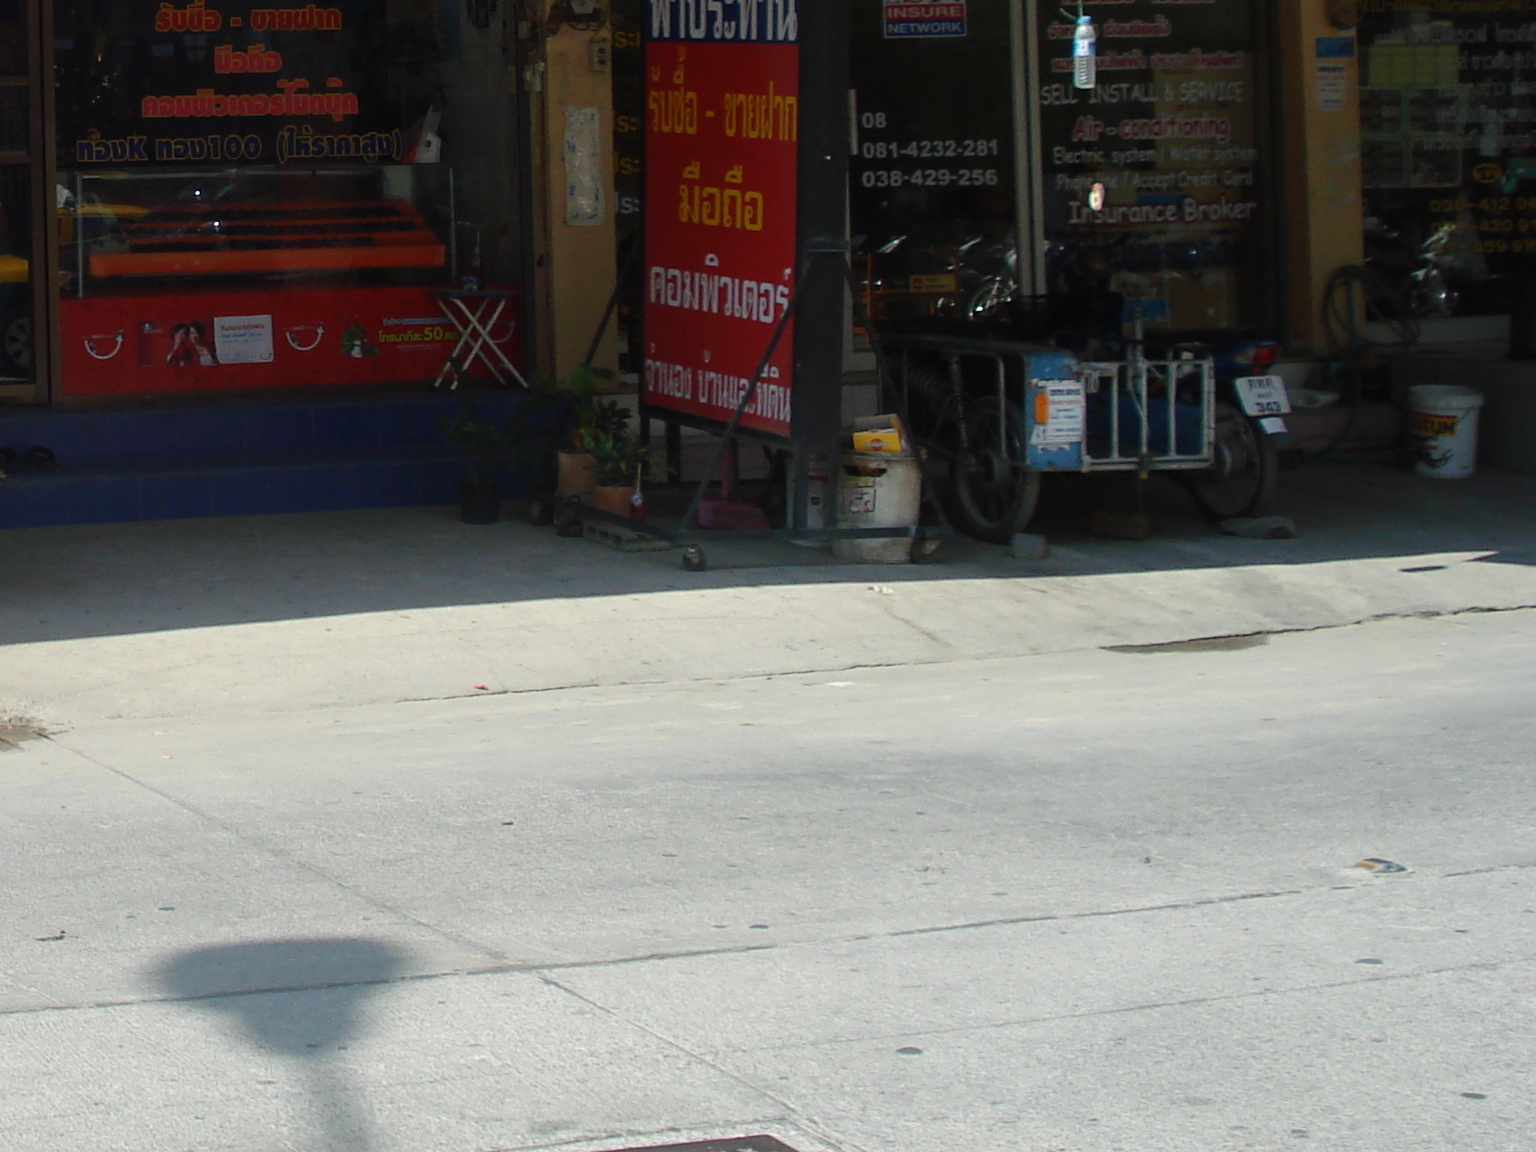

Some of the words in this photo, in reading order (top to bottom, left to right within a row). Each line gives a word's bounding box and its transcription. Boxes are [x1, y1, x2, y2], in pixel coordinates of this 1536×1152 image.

[250, 5, 342, 32] ขายฝาก
[886, 4, 962, 19] INSURE
[886, 20, 962, 36] NETWORK
[214, 43, 282, 75] มือถือ
[648, 45, 698, 135] รับซื้อ
[724, 80, 799, 142] ขายฝาก
[1040, 83, 1078, 105] SELL
[1089, 81, 1156, 104] INSTALL
[1180, 80, 1245, 103] SERVICE
[862, 140, 998, 159] 081-4232-281
[862, 169, 998, 188] 038-429-256
[678, 161, 764, 231] มือถือ
[1068, 200, 1178, 225] Insurance
[1182, 197, 1258, 223] Broker
[650, 253, 792, 324] คอมพิวเตอร์
[424, 326, 444, 342] 50
